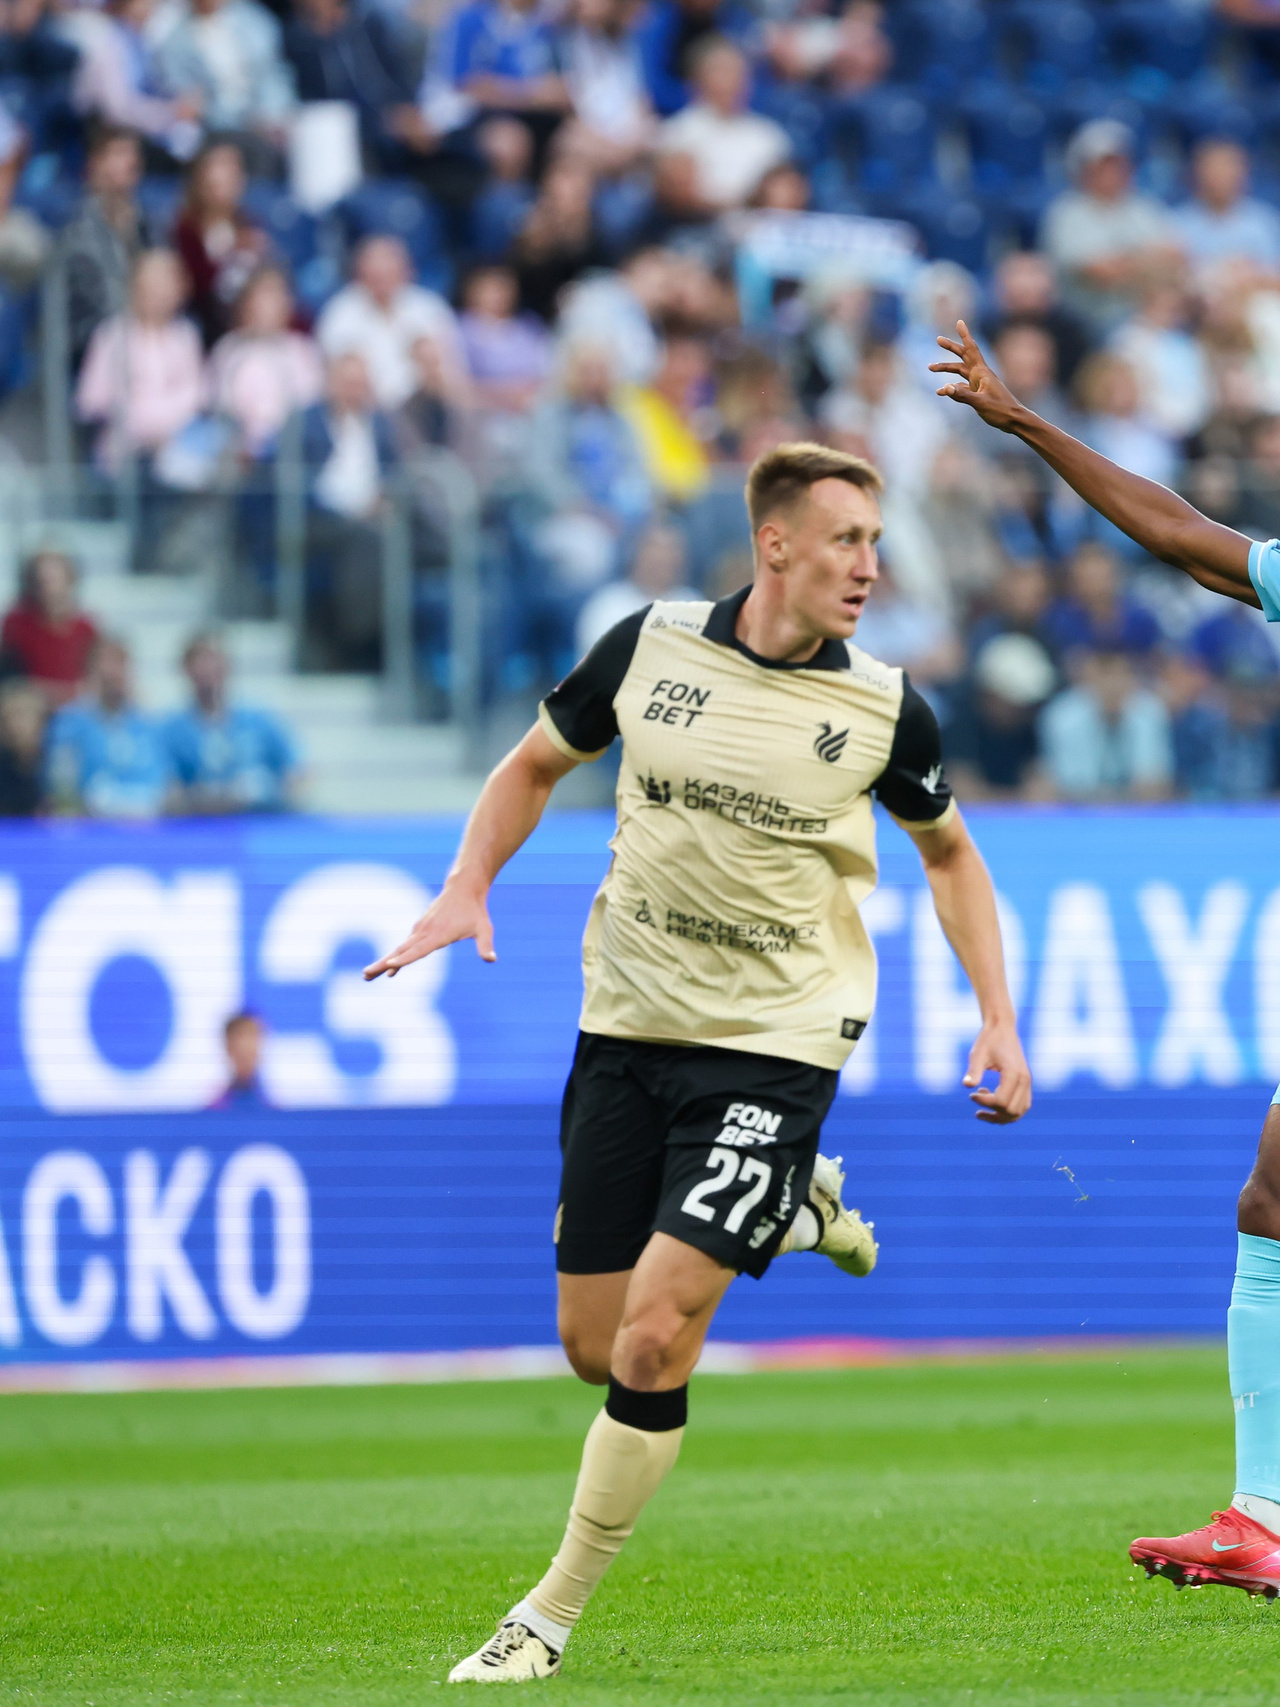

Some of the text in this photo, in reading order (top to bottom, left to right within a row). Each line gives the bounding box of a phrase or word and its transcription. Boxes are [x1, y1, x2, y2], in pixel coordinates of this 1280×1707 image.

[651, 679, 711, 707] FON
[643, 702, 703, 727] BET
[685, 777, 790, 816] КАЗАНЬ
[684, 794, 828, 834] ОРГСИНТЕЗ
[667, 909, 819, 940] НИЖНЕКАМСК
[667, 924, 790, 953] НЕФТЕХИМ
[722, 1102, 783, 1135] FON
[714, 1125, 777, 1147] BET
[680, 1147, 772, 1234] 27
